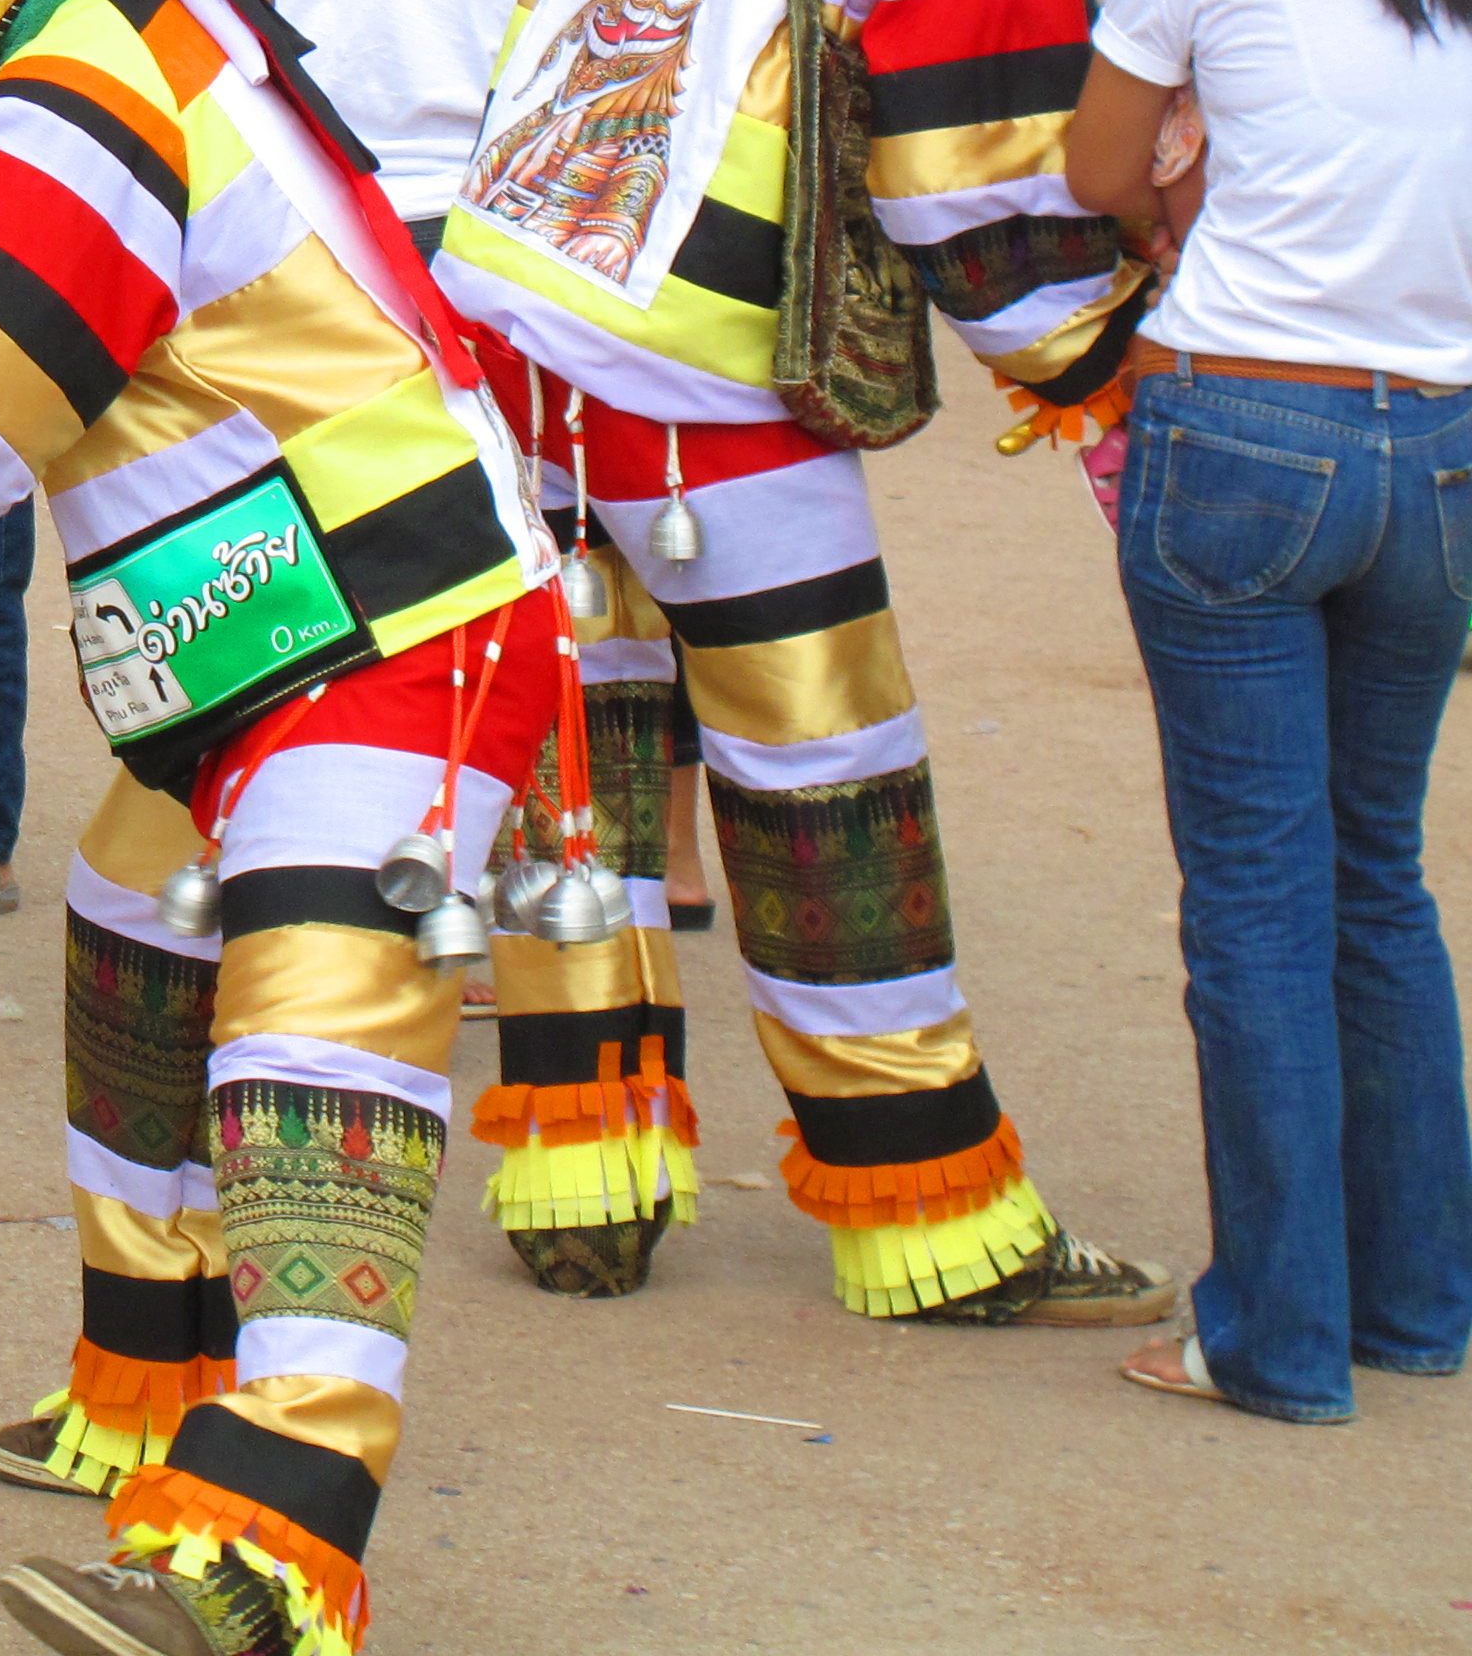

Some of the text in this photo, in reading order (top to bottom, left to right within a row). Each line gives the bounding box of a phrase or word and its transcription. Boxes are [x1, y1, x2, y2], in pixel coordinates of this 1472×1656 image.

[137, 523, 299, 663] ด่านซ้าย
[271, 625, 294, 654] 0
